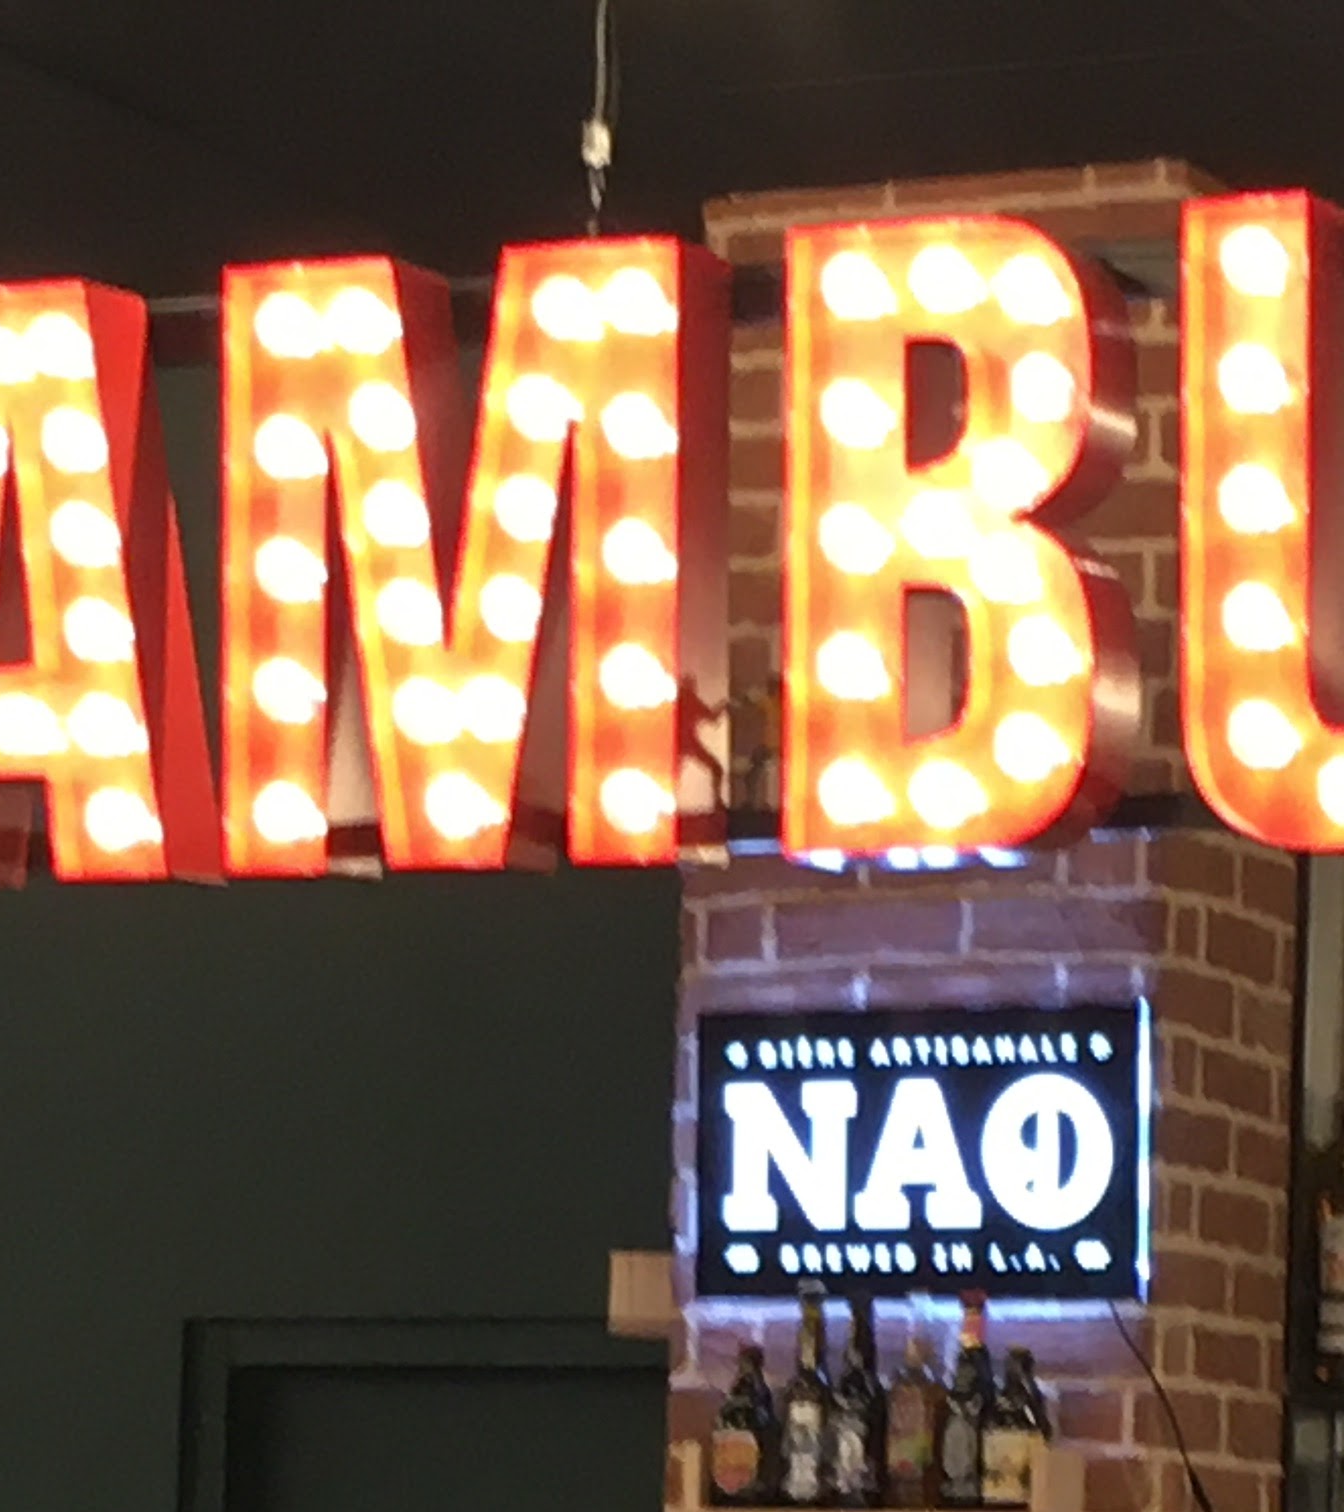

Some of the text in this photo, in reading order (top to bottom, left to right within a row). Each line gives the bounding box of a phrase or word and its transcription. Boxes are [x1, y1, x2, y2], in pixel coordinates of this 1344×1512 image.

[722, 1073, 1115, 1232] NAO
[780, 1242, 917, 1273] BREWED
[933, 1242, 973, 1273] IN
